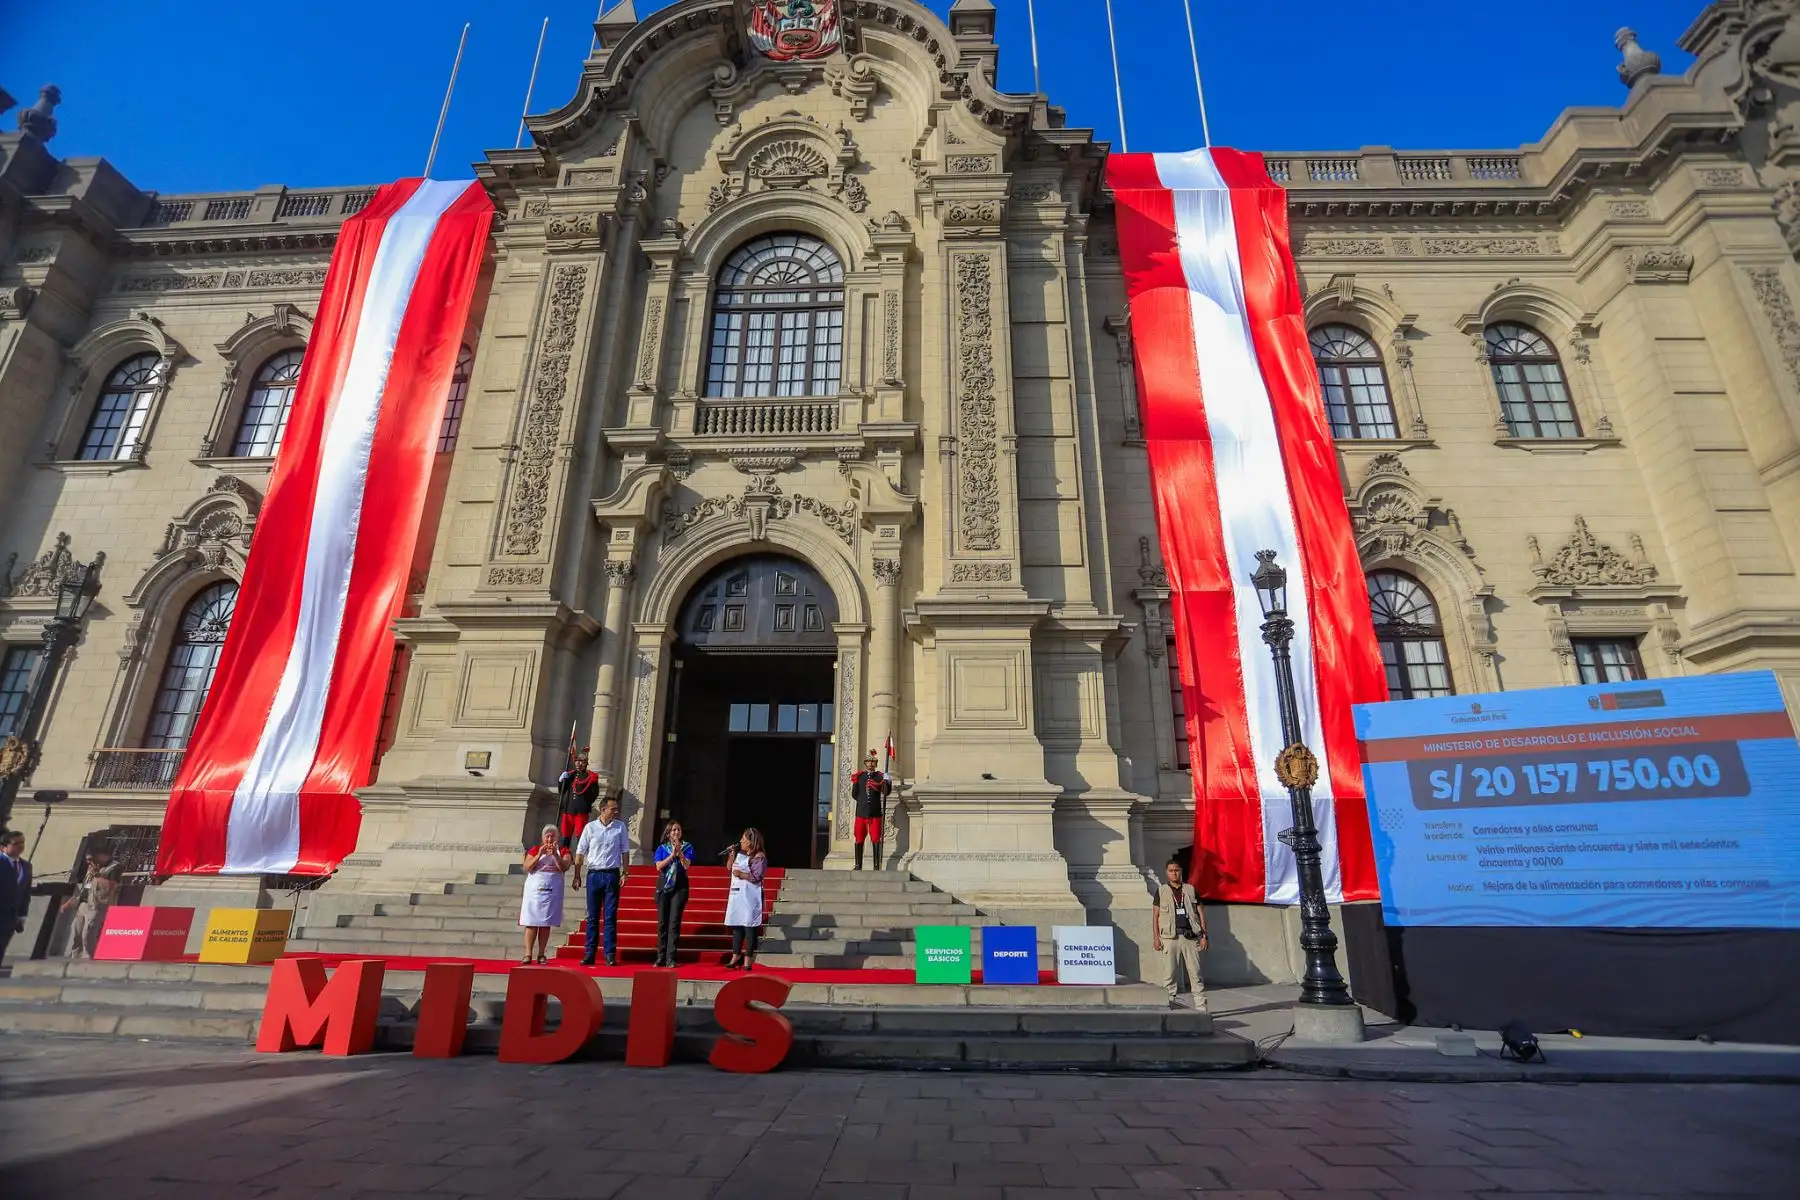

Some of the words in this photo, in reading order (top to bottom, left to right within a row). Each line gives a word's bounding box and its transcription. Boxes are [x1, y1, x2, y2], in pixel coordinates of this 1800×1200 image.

[1424, 740, 1483, 753] MINISTERIO
[1486, 739, 1501, 749] DE
[1503, 734, 1577, 748] DESARROLLO
[1580, 733, 1587, 743] E
[1589, 727, 1652, 742] INCLUSIÓN
[1654, 726, 1700, 738] SOCIAL
[1429, 763, 1463, 802] S/
[1471, 766, 1516, 797] 20
[1521, 762, 1578, 795] 157
[1587, 754, 1721, 792] 750.00
[1473, 826, 1523, 835] Comedores
[1525, 826, 1531, 835] y
[1532, 824, 1553, 833] ollas
[1555, 823, 1598, 832] comunes
[1476, 845, 1505, 855] Veinte
[1506, 844, 1546, 854] millones
[1547, 842, 1576, 853] ciento
[1578, 841, 1626, 852] cincuenta
[1628, 842, 1635, 853] y
[1635, 840, 1660, 851] siete
[1661, 840, 1677, 850] mil
[1679, 838, 1740, 850] setecientos
[1479, 858, 1524, 868] cincuenta
[1525, 859, 1531, 868] y
[1532, 857, 1564, 867] 00/100
[1483, 881, 1514, 892] Mejora
[1515, 881, 1527, 890] de
[1529, 880, 1538, 890] la
[1540, 880, 1600, 890] alimentación
[1603, 881, 1625, 891] para
[1627, 879, 1684, 889] comedores
[1685, 881, 1691, 890] y
[1694, 879, 1717, 889] ollas
[105, 928, 144, 936] EDUCACIÓN
[254, 957, 795, 1075] MIDIS
